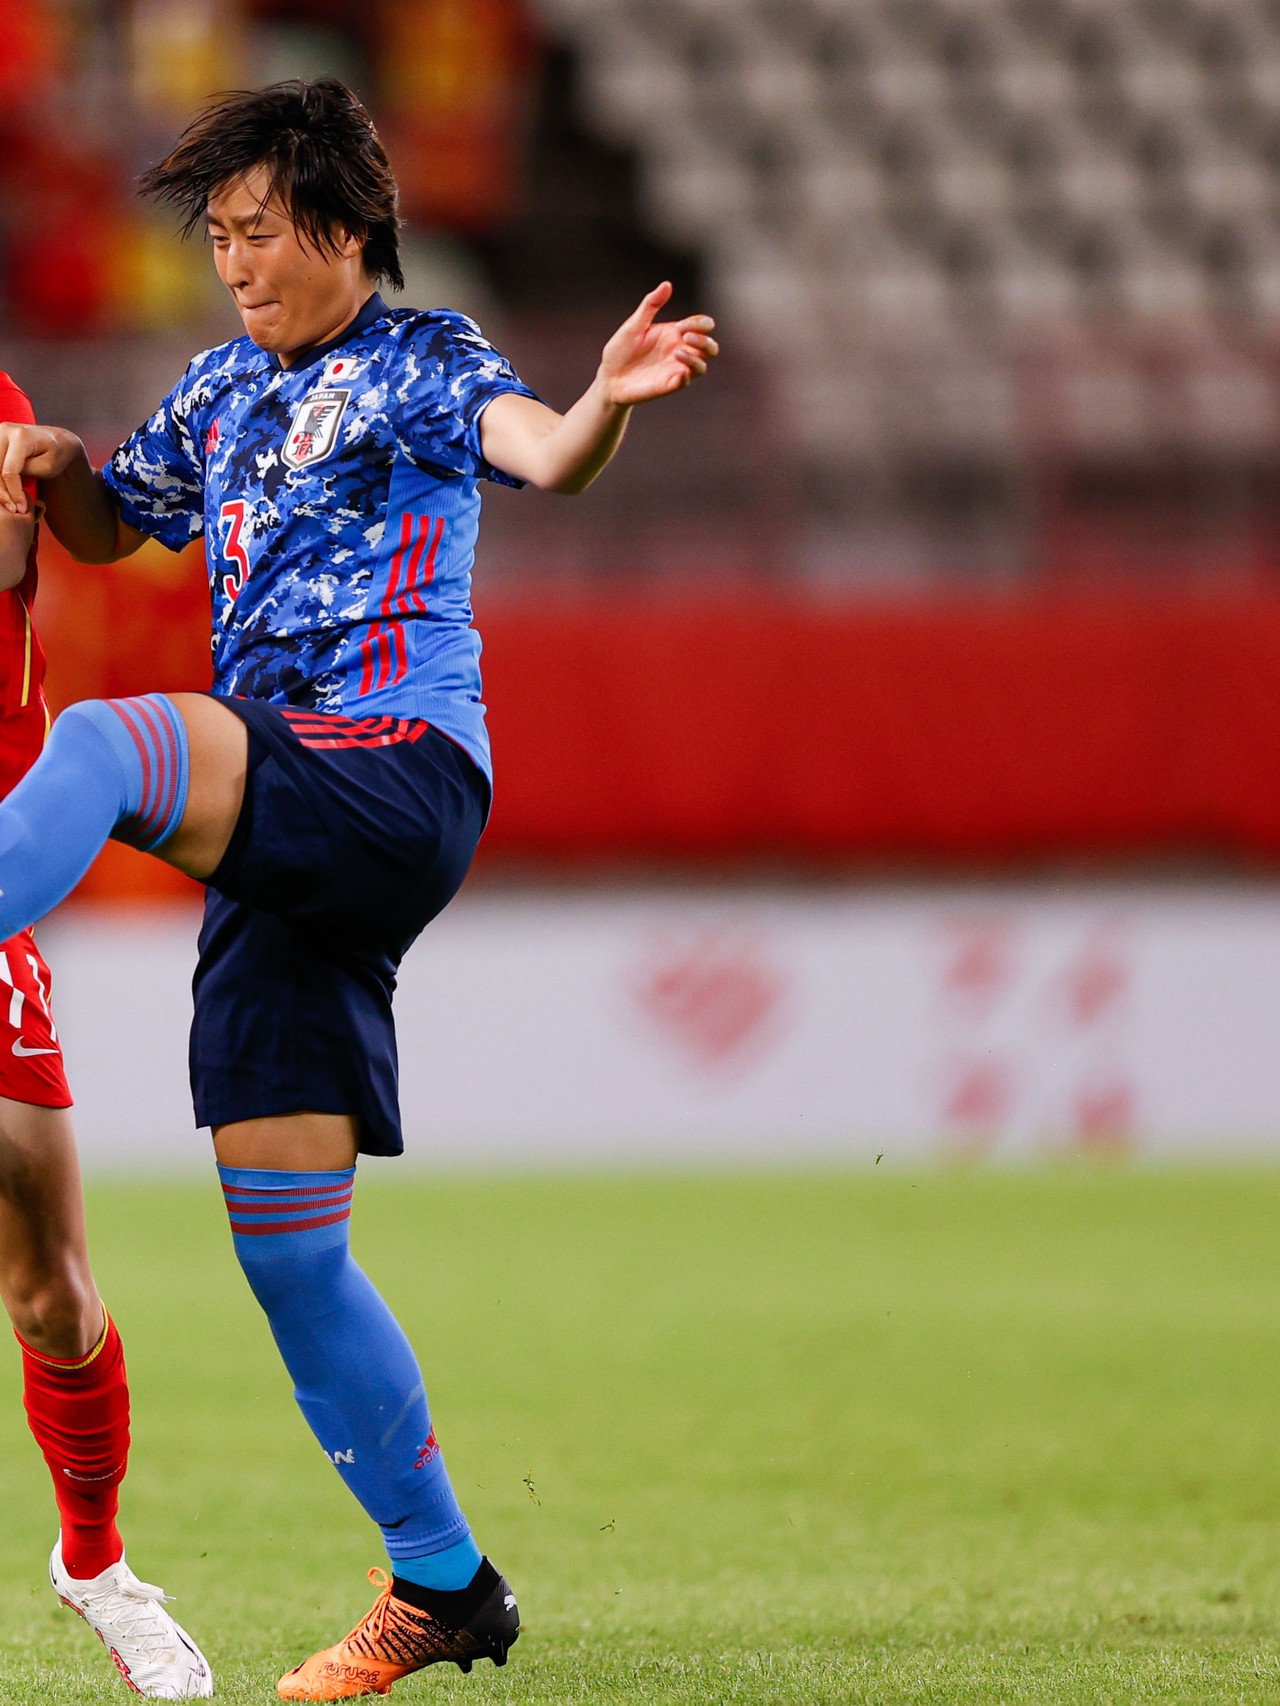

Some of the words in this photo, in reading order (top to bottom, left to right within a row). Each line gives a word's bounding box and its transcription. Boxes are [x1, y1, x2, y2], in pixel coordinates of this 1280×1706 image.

[309, 392, 336, 402] JAPAN
[292, 443, 314, 457] JFA
[220, 498, 252, 603] 3
